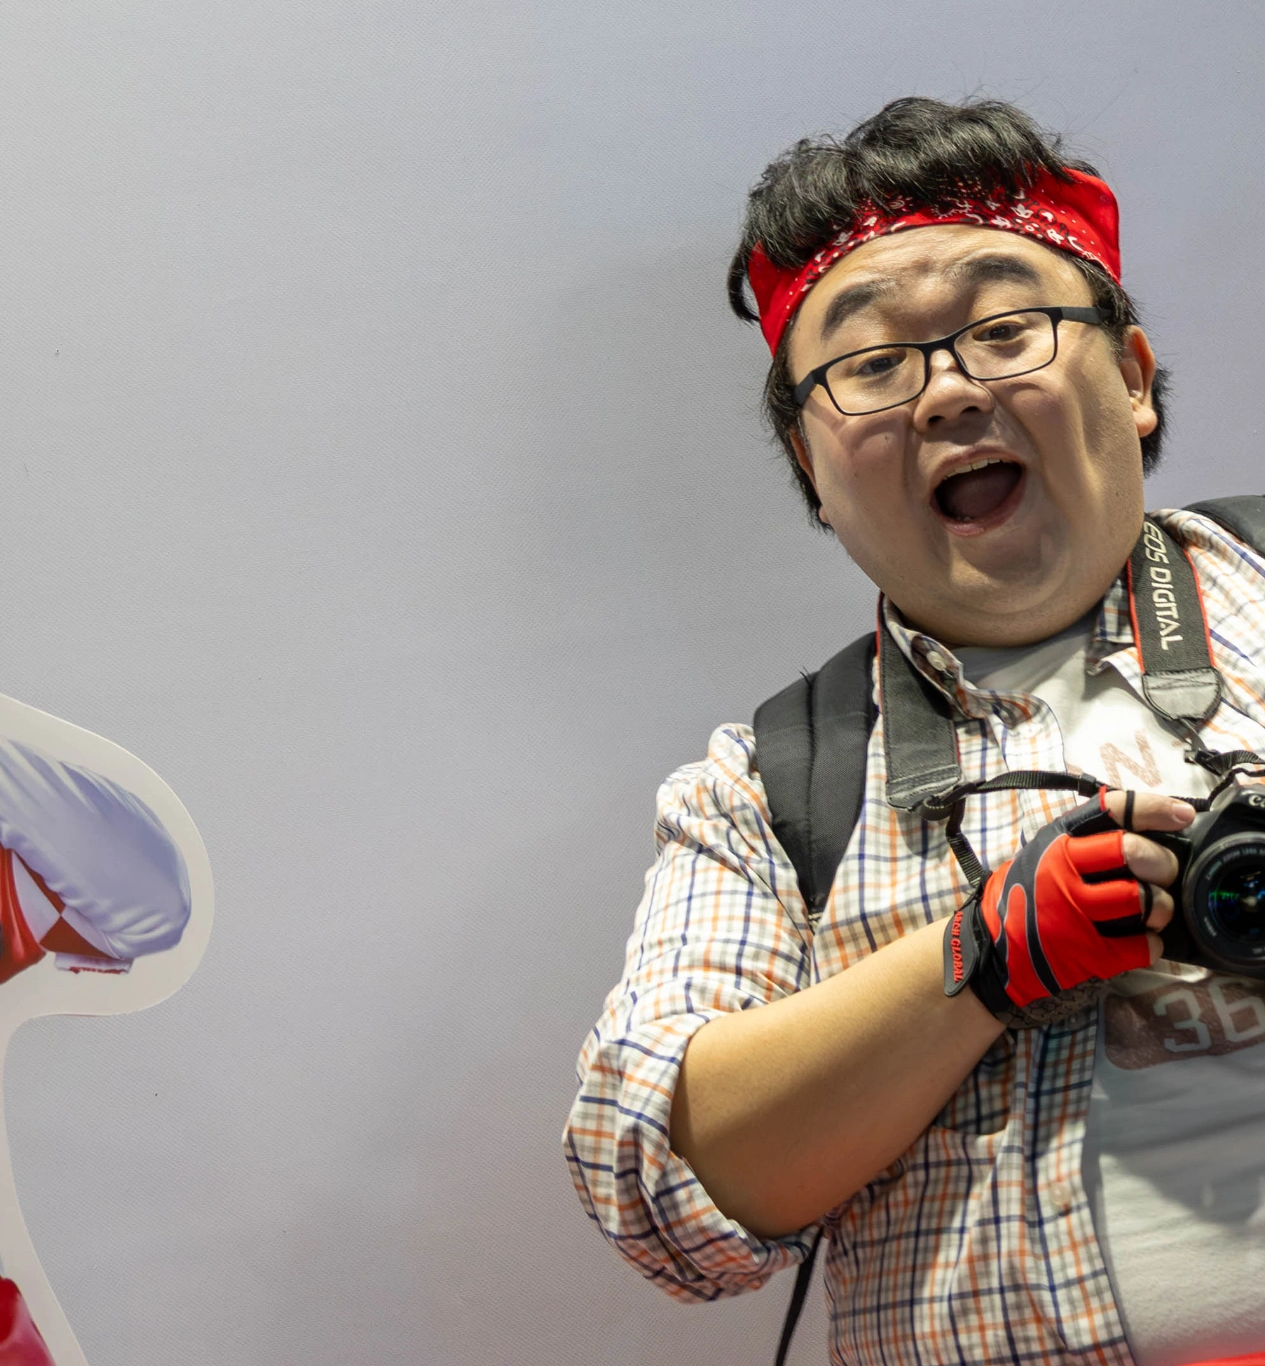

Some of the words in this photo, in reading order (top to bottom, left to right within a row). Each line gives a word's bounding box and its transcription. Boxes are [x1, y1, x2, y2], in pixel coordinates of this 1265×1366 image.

[1143, 521, 1169, 564] EOS
[1149, 566, 1183, 651] DIGITAL
[950, 938, 964, 983] GLOBAL
